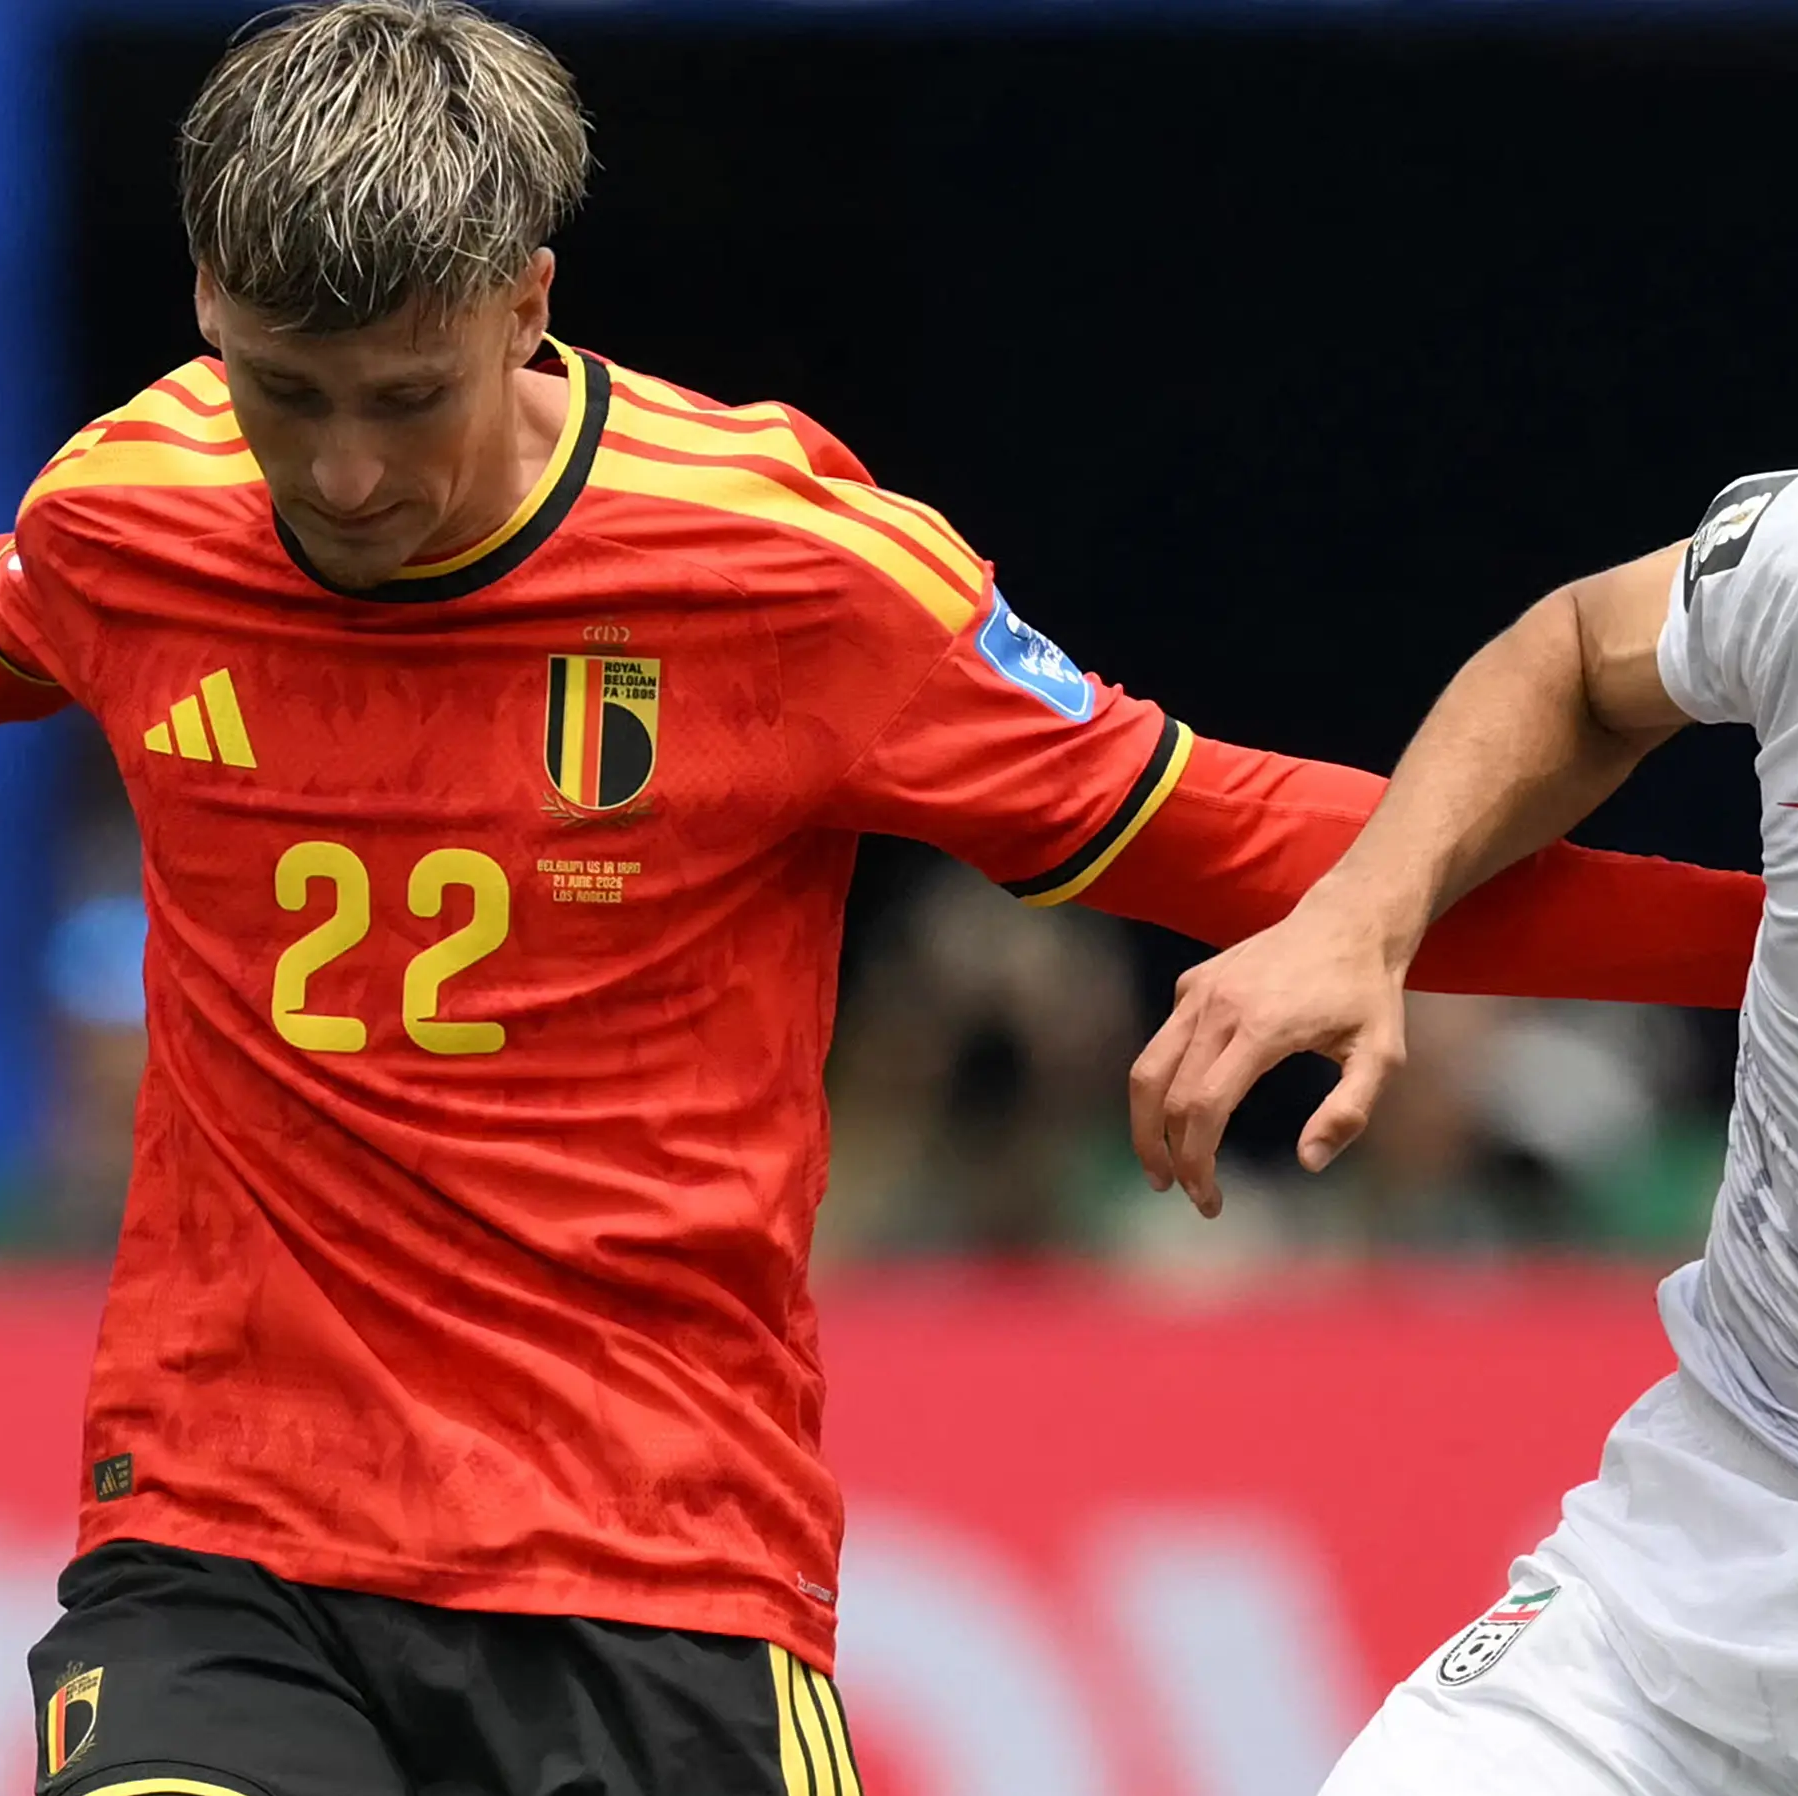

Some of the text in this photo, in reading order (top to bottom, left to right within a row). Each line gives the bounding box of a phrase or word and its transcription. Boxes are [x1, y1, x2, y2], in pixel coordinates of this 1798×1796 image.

[604, 661, 643, 674] ROYAL
[603, 674, 657, 688] BELGIAN
[603, 686, 619, 698] FA
[552, 874, 565, 888] 21
[595, 876, 624, 890] 2026
[552, 889, 573, 902] LOS
[271, 840, 510, 1054] 22
